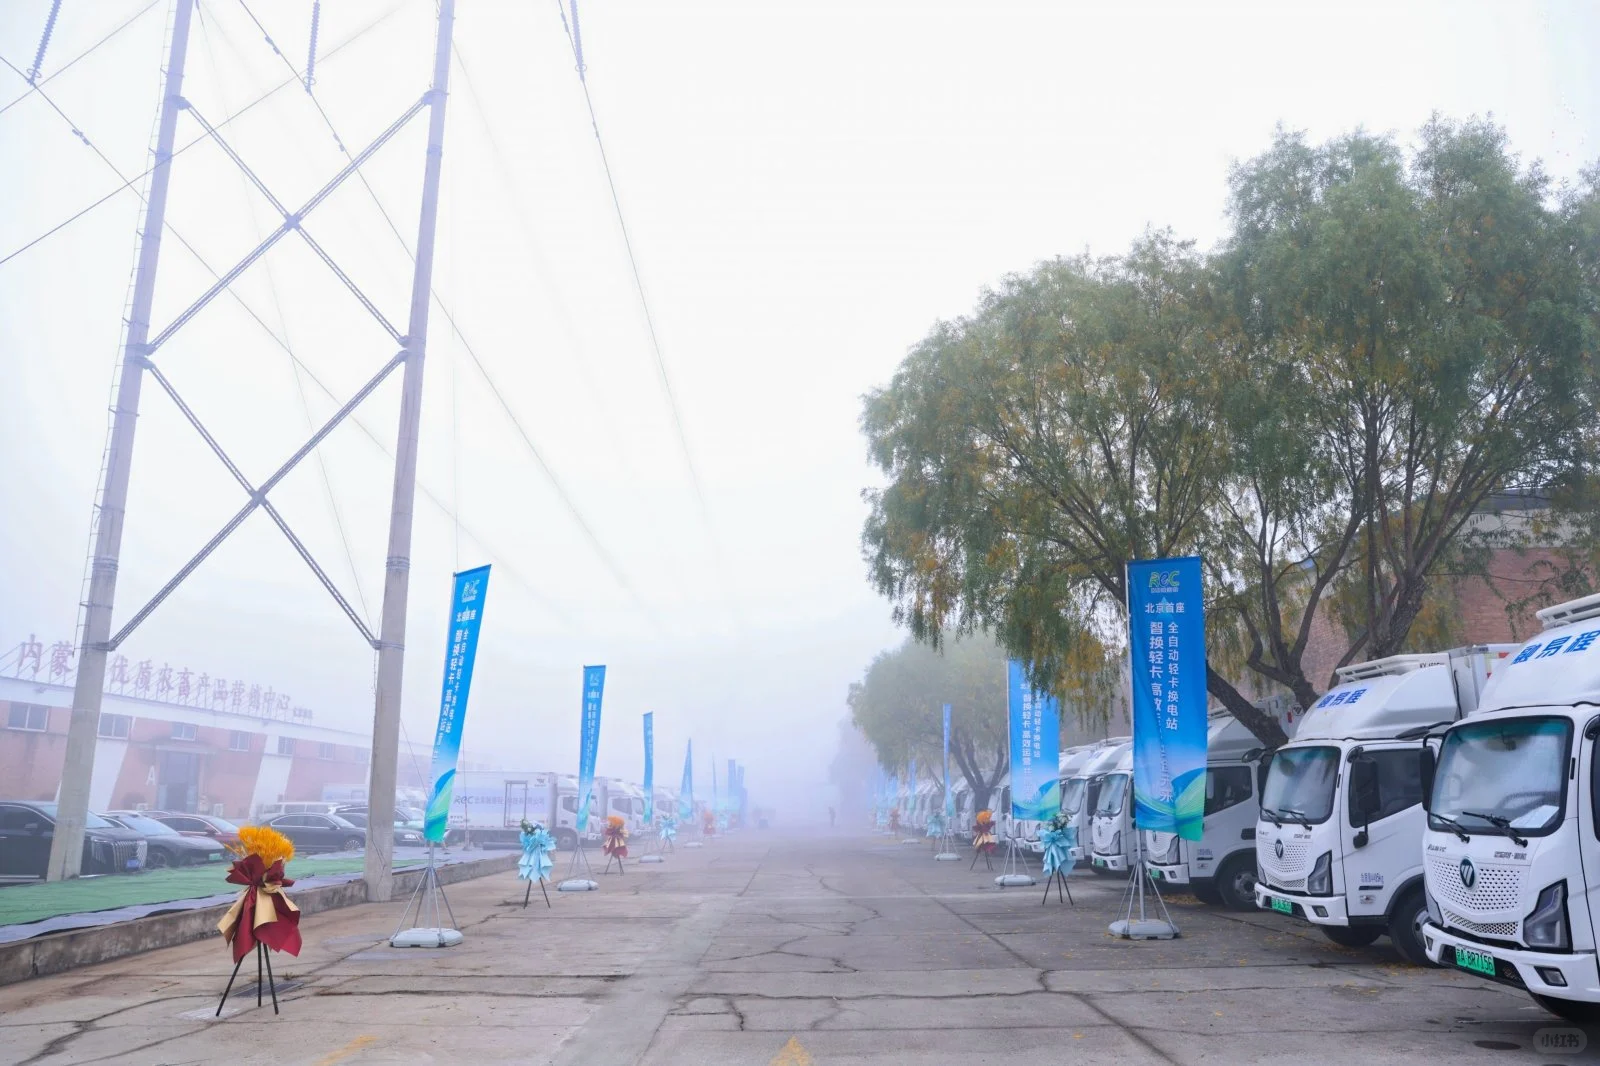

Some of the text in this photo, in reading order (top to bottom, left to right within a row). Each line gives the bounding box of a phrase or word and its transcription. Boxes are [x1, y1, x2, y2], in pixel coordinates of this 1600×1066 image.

[1145, 602, 1185, 614] 北京首座
[18, 633, 292, 713] 内蒙优质农畜产品营销中心
[1165, 621, 1179, 731] 全自动轻卡换电站
[144, 766, 157, 786] A
